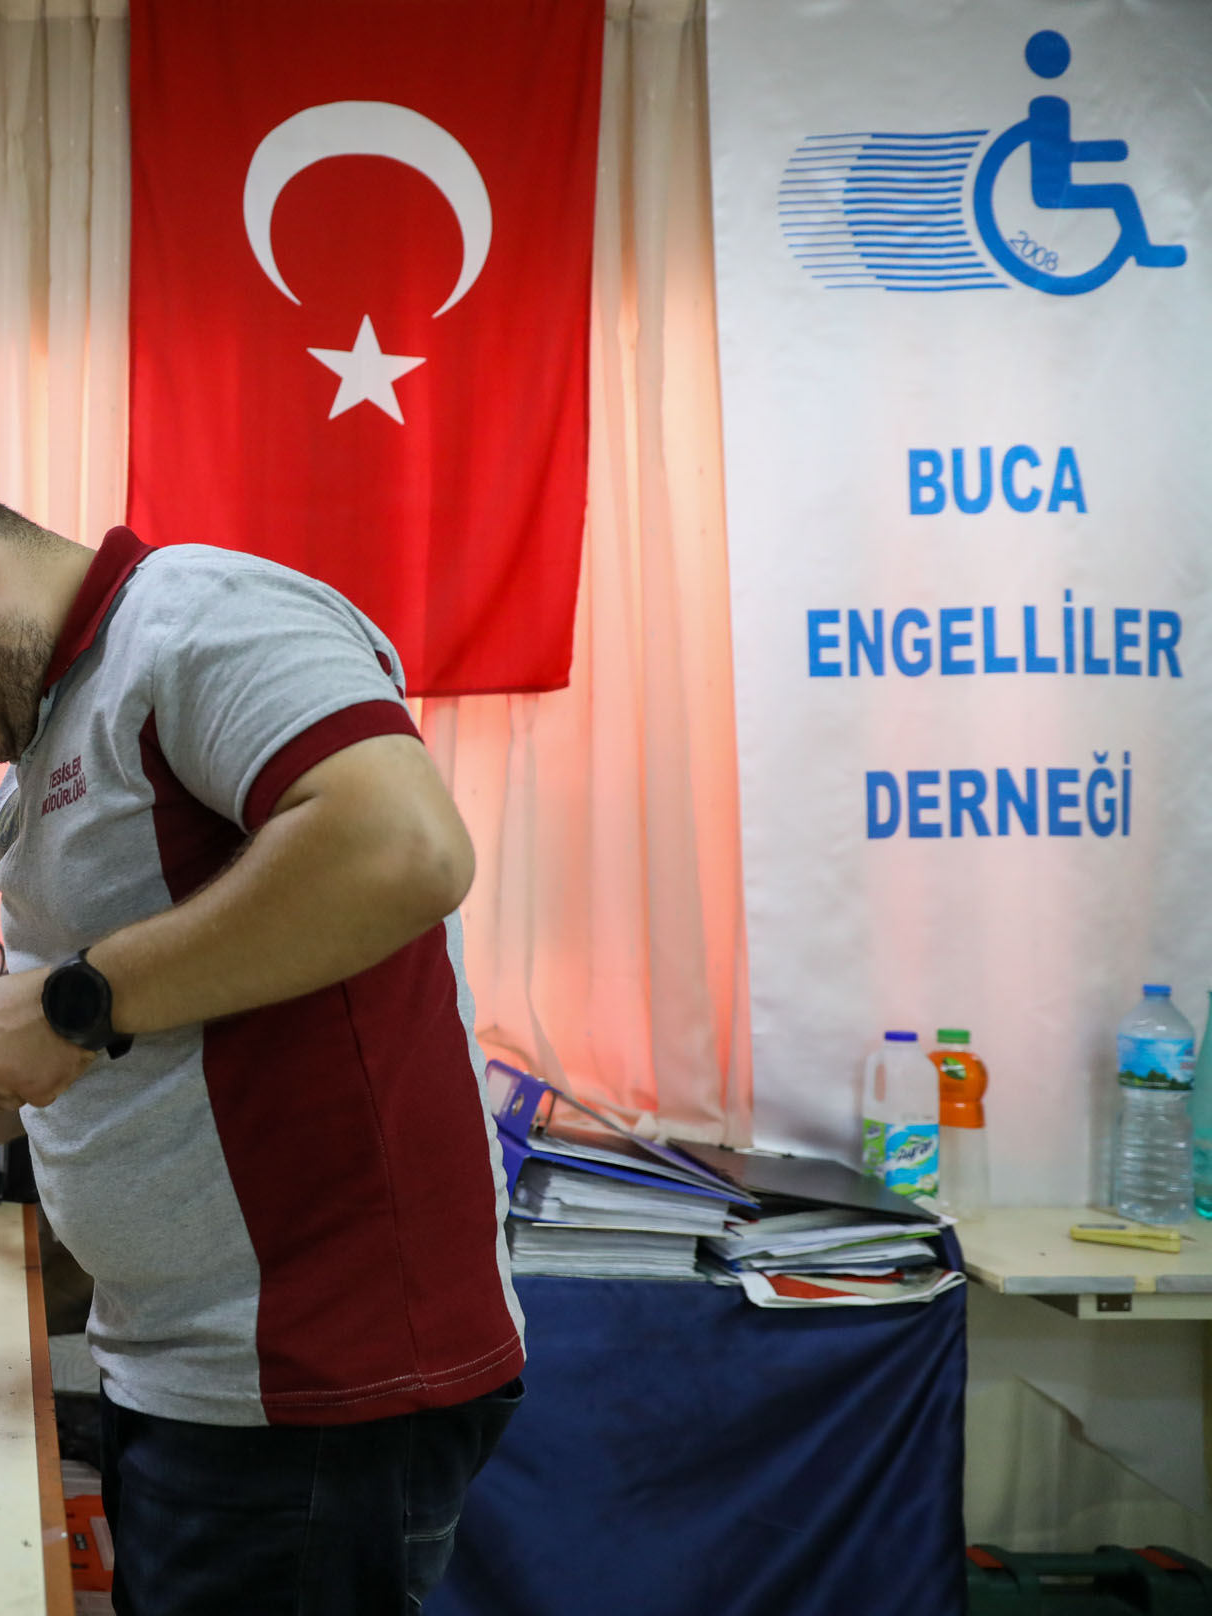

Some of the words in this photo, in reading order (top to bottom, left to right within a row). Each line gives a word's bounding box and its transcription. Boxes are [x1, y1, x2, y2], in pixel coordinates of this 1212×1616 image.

[1010, 230, 1059, 272] 2008
[908, 444, 1089, 516] BUCA
[807, 588, 1183, 679] ENGELLİLER
[865, 750, 1132, 840] DERNEĞİ
